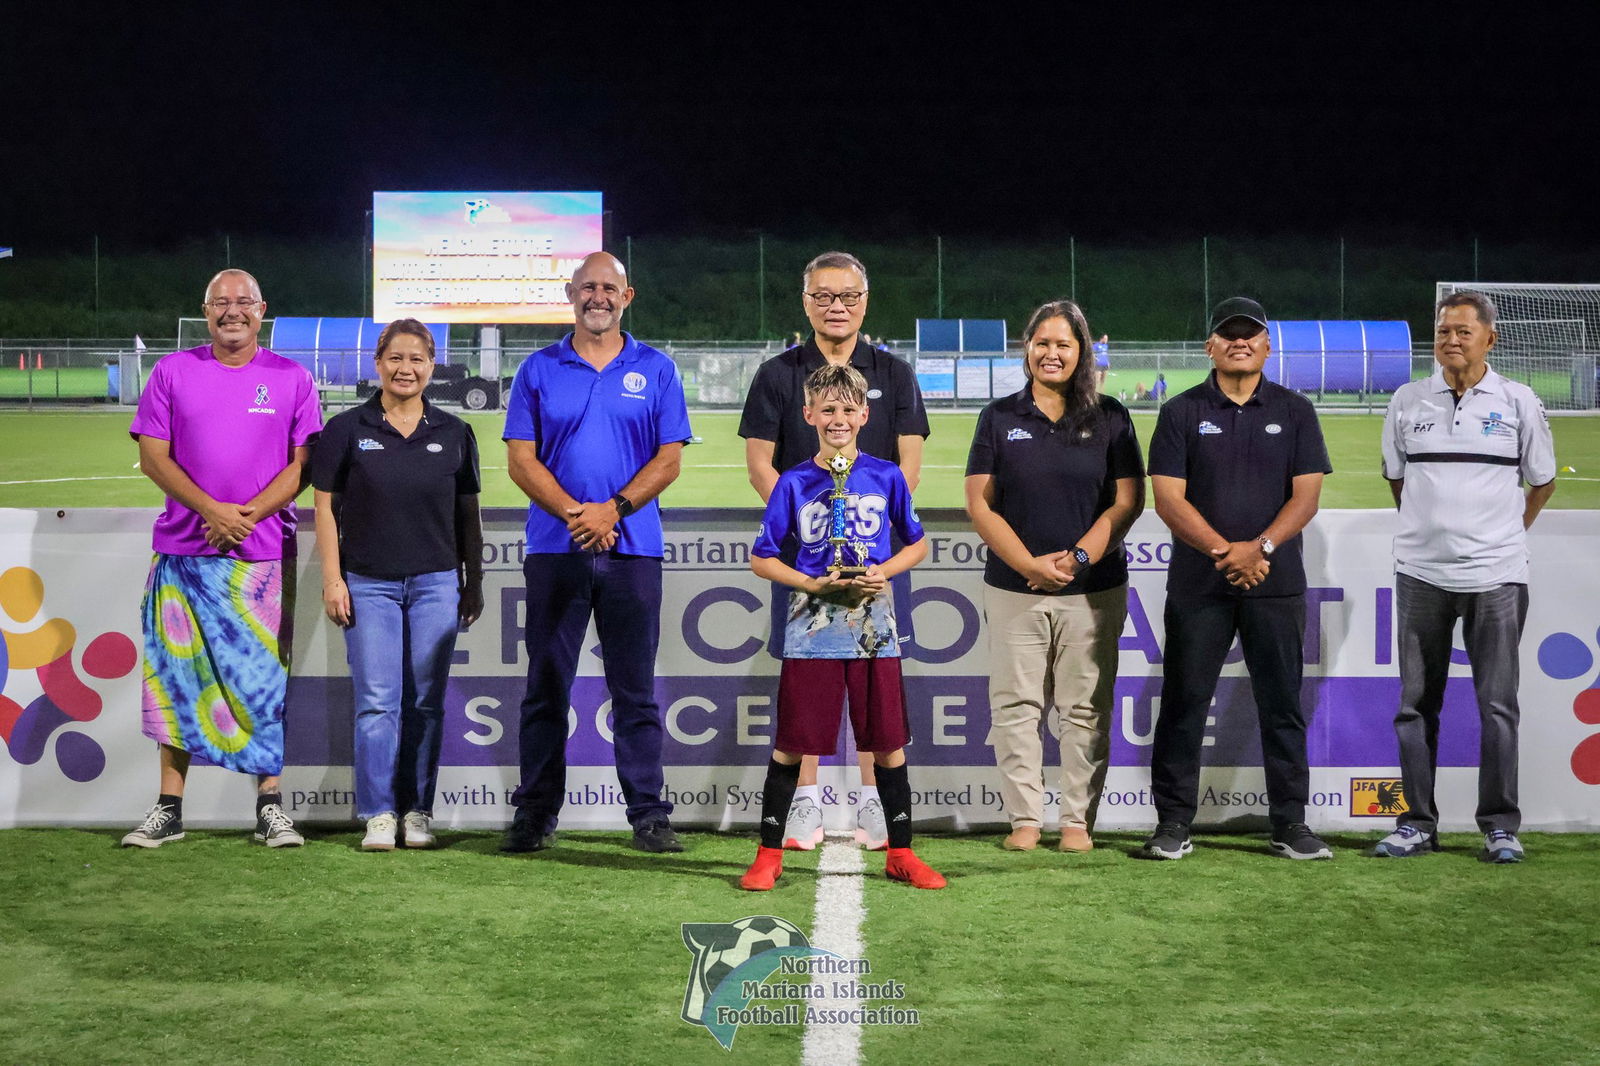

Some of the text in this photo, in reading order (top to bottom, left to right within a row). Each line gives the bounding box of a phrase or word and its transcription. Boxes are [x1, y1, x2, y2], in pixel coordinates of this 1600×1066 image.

[442, 784, 497, 806] with
[568, 784, 627, 806] ublic
[660, 784, 718, 806] hool
[821, 785, 839, 806] &
[1354, 782, 1377, 792] JFA
